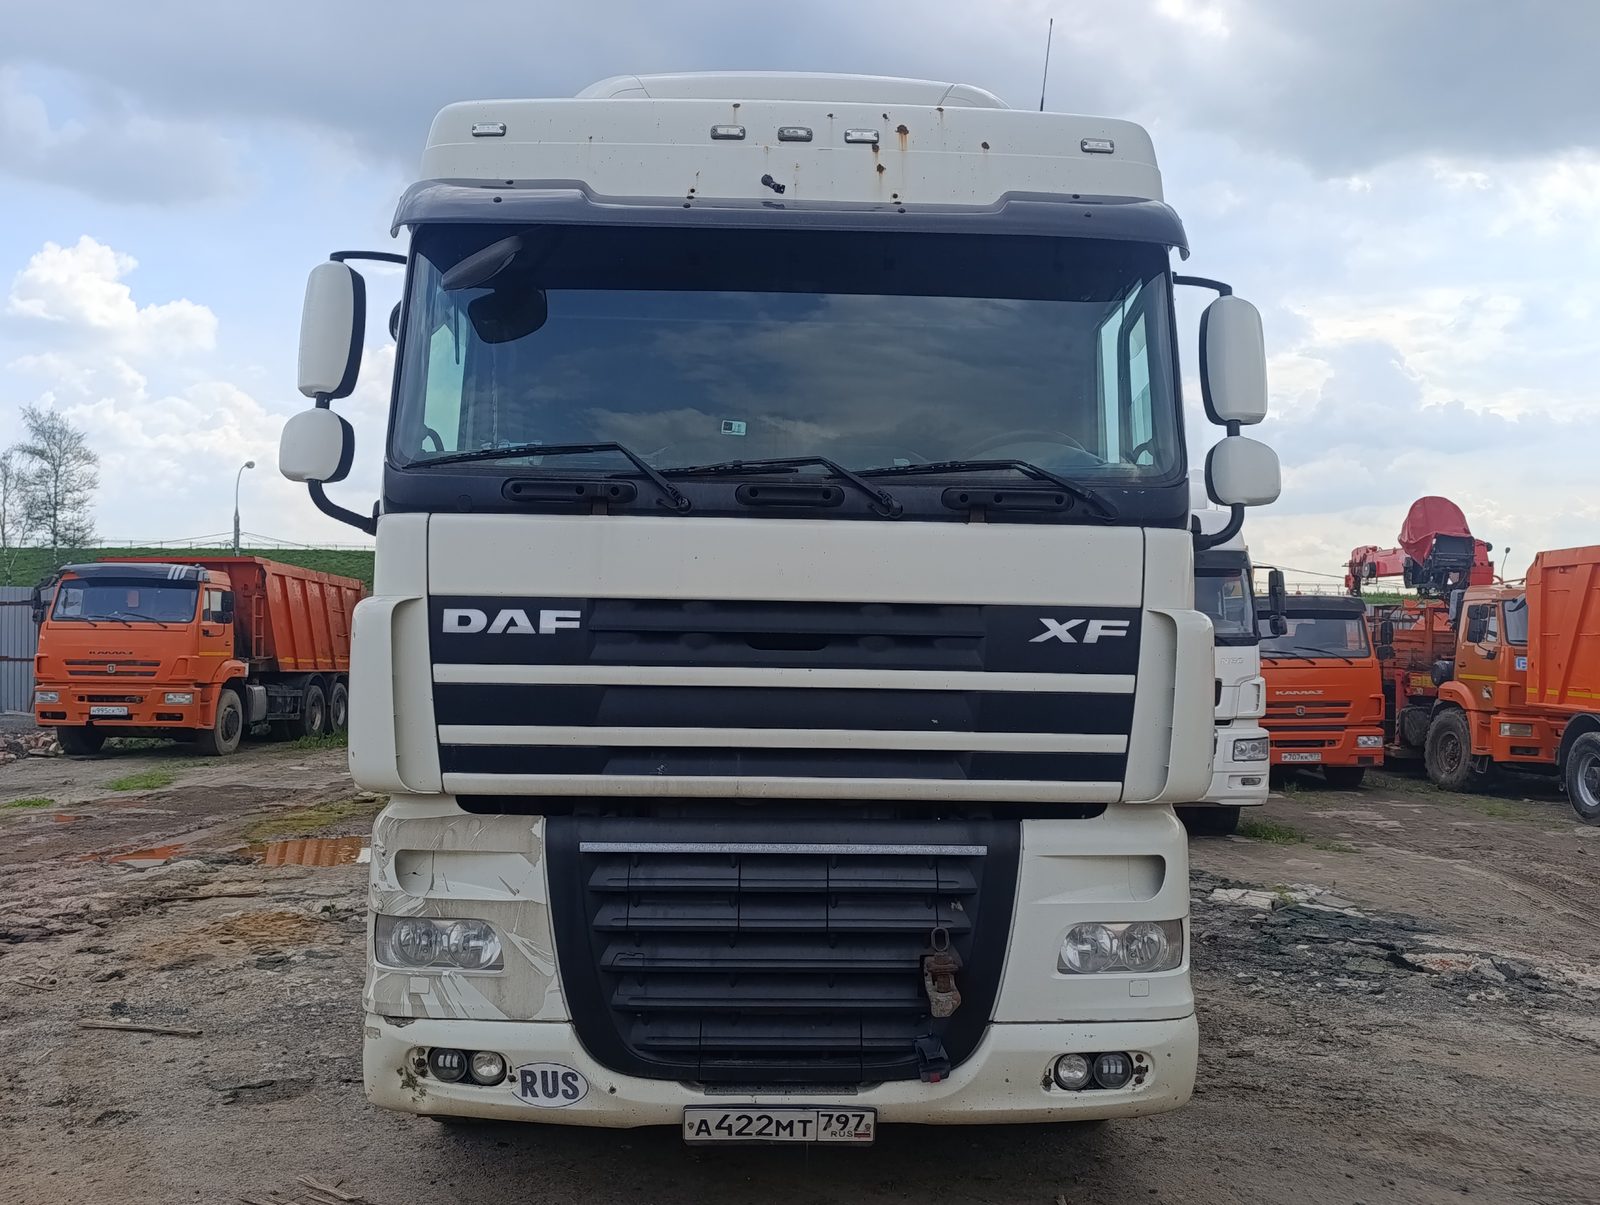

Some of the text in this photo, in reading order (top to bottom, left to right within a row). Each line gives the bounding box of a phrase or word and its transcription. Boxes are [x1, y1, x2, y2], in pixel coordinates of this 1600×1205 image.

[441, 608, 582, 634] DAF
[1028, 618, 1131, 644] XF
[520, 1070, 580, 1100] RUS
[695, 1114, 866, 1137] A422MT 797
